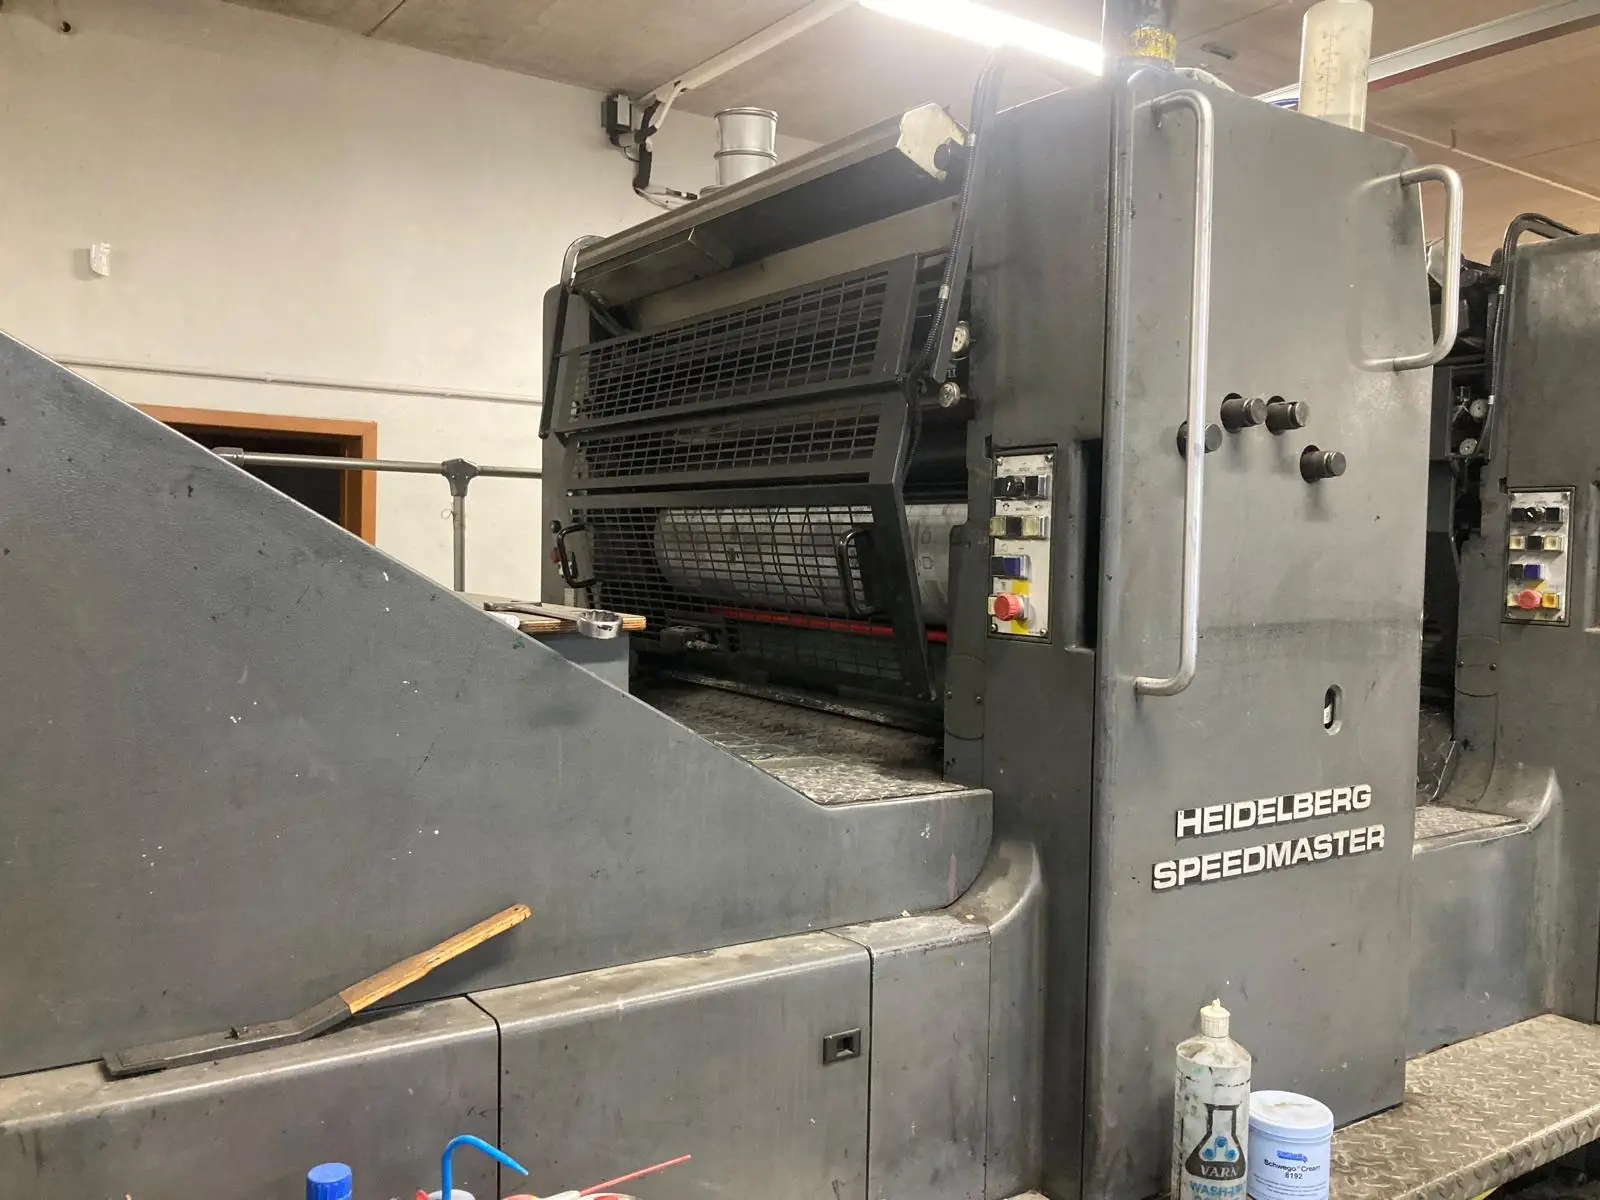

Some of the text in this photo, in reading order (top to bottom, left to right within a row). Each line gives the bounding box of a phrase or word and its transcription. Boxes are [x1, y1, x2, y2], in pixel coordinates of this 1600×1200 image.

[1175, 784, 1372, 838] HEIDELBERG
[1152, 824, 1386, 890] SPEEDMASTER
[1284, 1172, 1303, 1180] 8192
